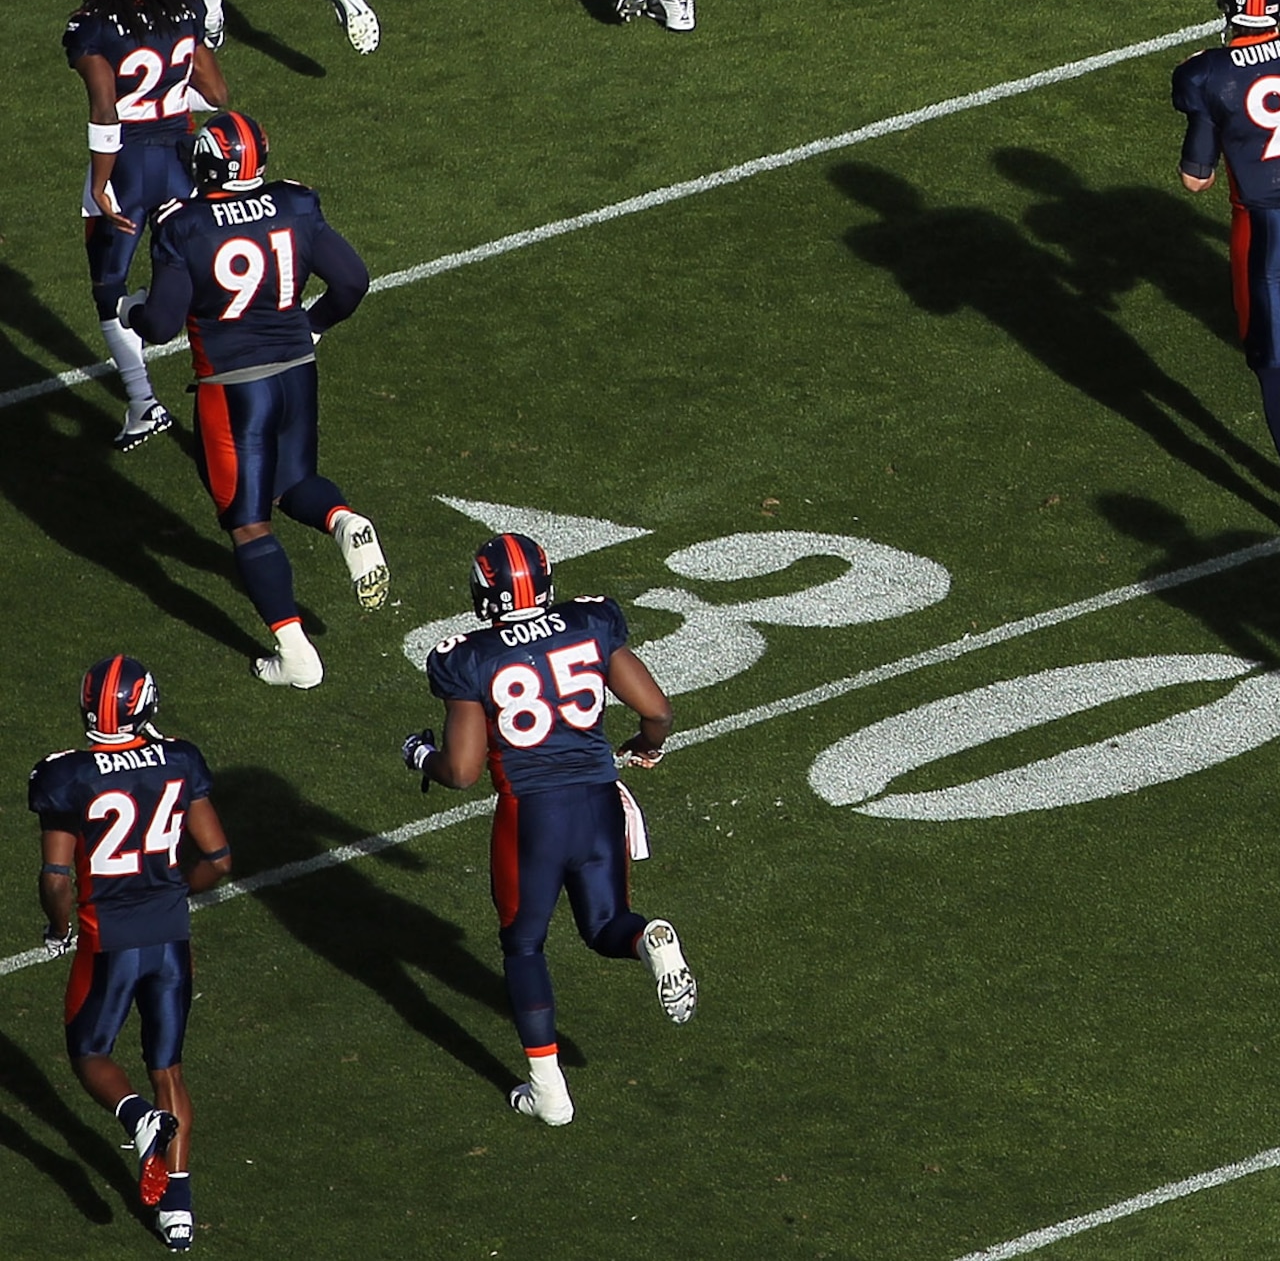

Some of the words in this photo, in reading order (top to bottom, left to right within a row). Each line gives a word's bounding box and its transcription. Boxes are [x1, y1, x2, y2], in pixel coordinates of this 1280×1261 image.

[114, 35, 197, 123] 22
[212, 195, 278, 226] FIELDS
[212, 226, 296, 321] 91
[499, 613, 567, 647] COATS
[490, 636, 607, 747] 85
[93, 743, 167, 775] BAILEY
[86, 779, 185, 878] 24
